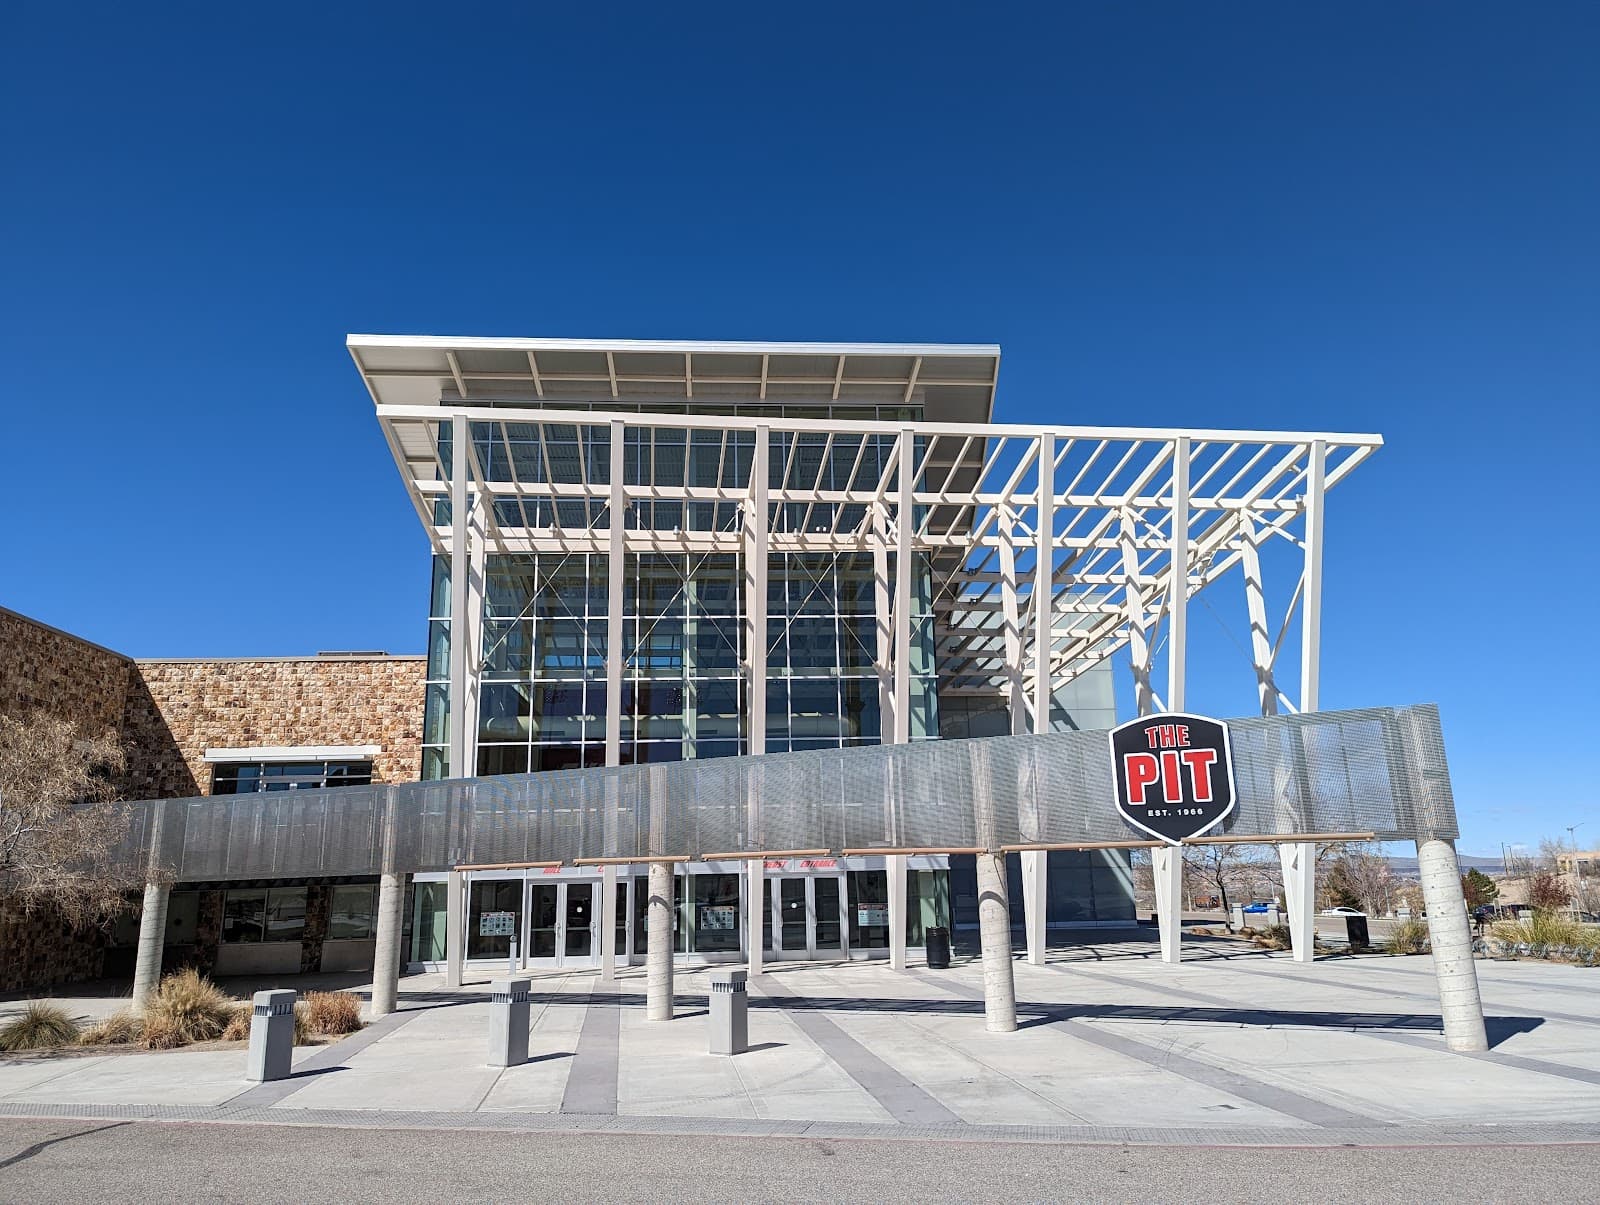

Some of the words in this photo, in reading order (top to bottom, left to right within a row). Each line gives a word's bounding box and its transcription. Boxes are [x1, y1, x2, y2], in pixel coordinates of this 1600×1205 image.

[1145, 724, 1190, 748] THE
[1123, 748, 1217, 805] PIT
[1147, 809, 1172, 817] EST.
[1177, 808, 1204, 816] 1966
